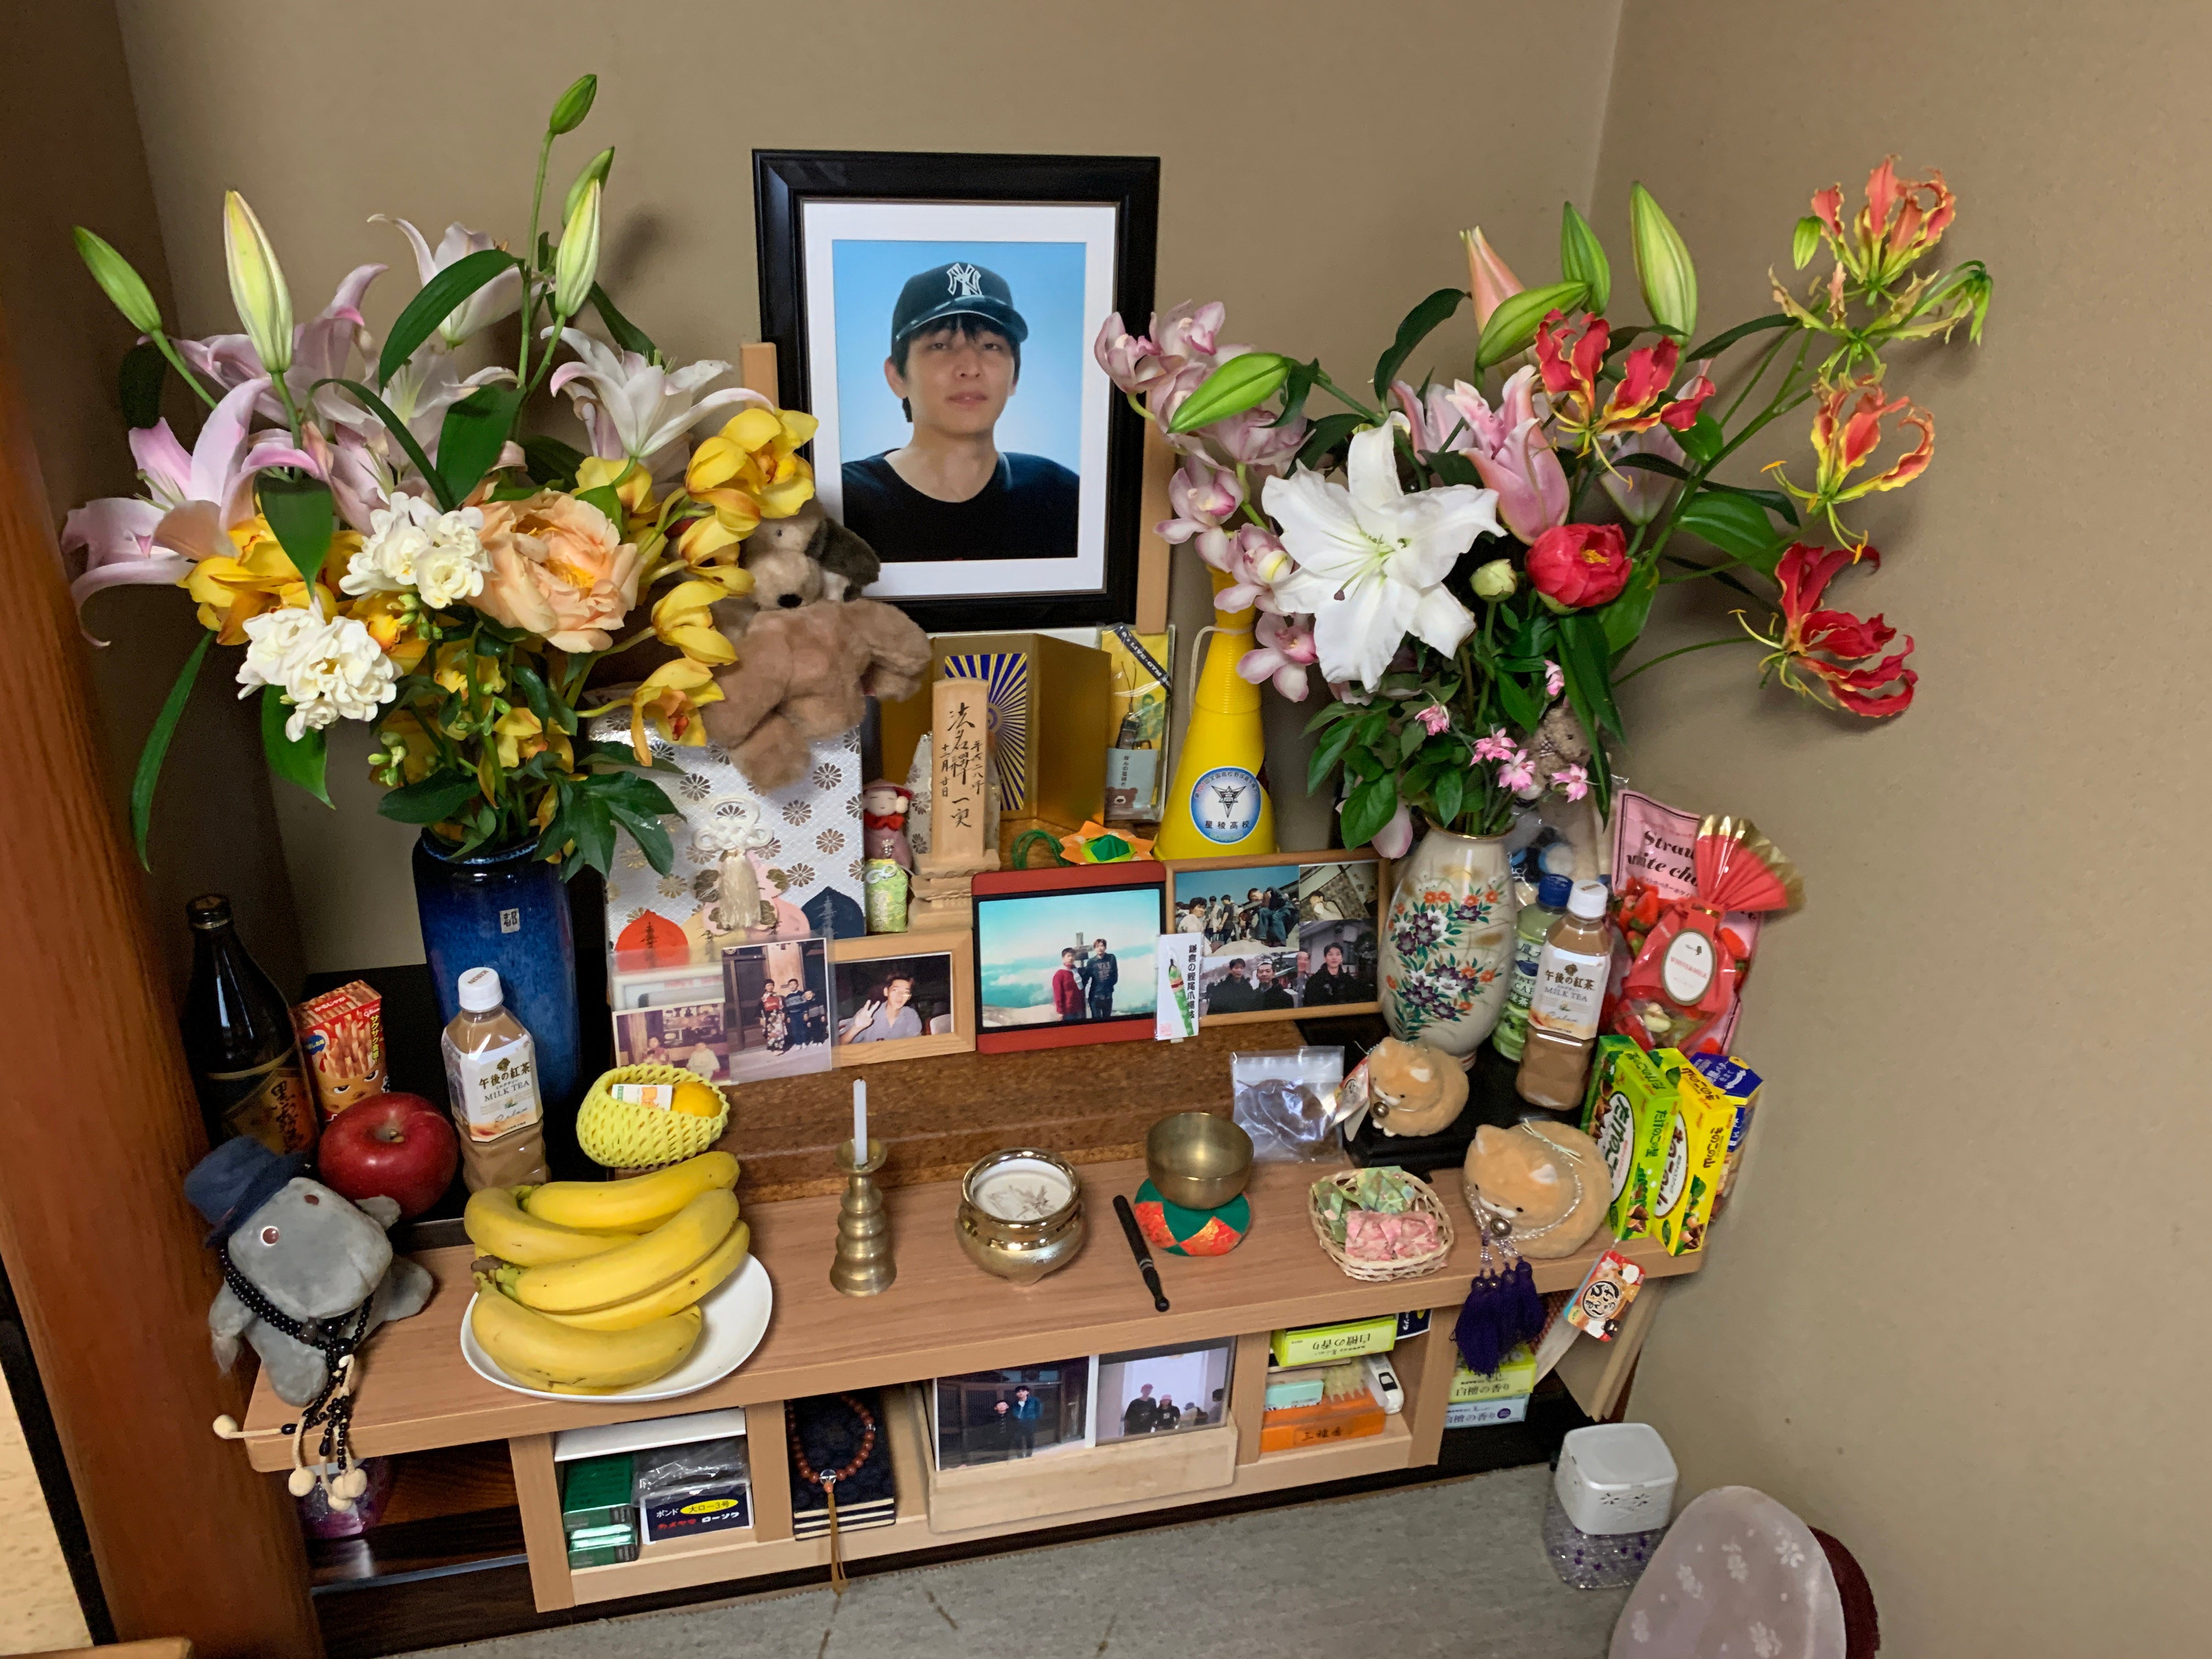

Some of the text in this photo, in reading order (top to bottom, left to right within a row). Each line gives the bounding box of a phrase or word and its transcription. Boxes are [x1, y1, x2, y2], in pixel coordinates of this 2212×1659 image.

[946, 263, 982, 295] NY
[1545, 969, 1595, 991] 午後の紅茶
[1544, 987, 1588, 1002] MILK TEA
[479, 1062, 531, 1090] 午後の紅茶
[484, 1080, 530, 1103] MILK TEA
[1645, 1109, 1668, 1158] たけのこの里
